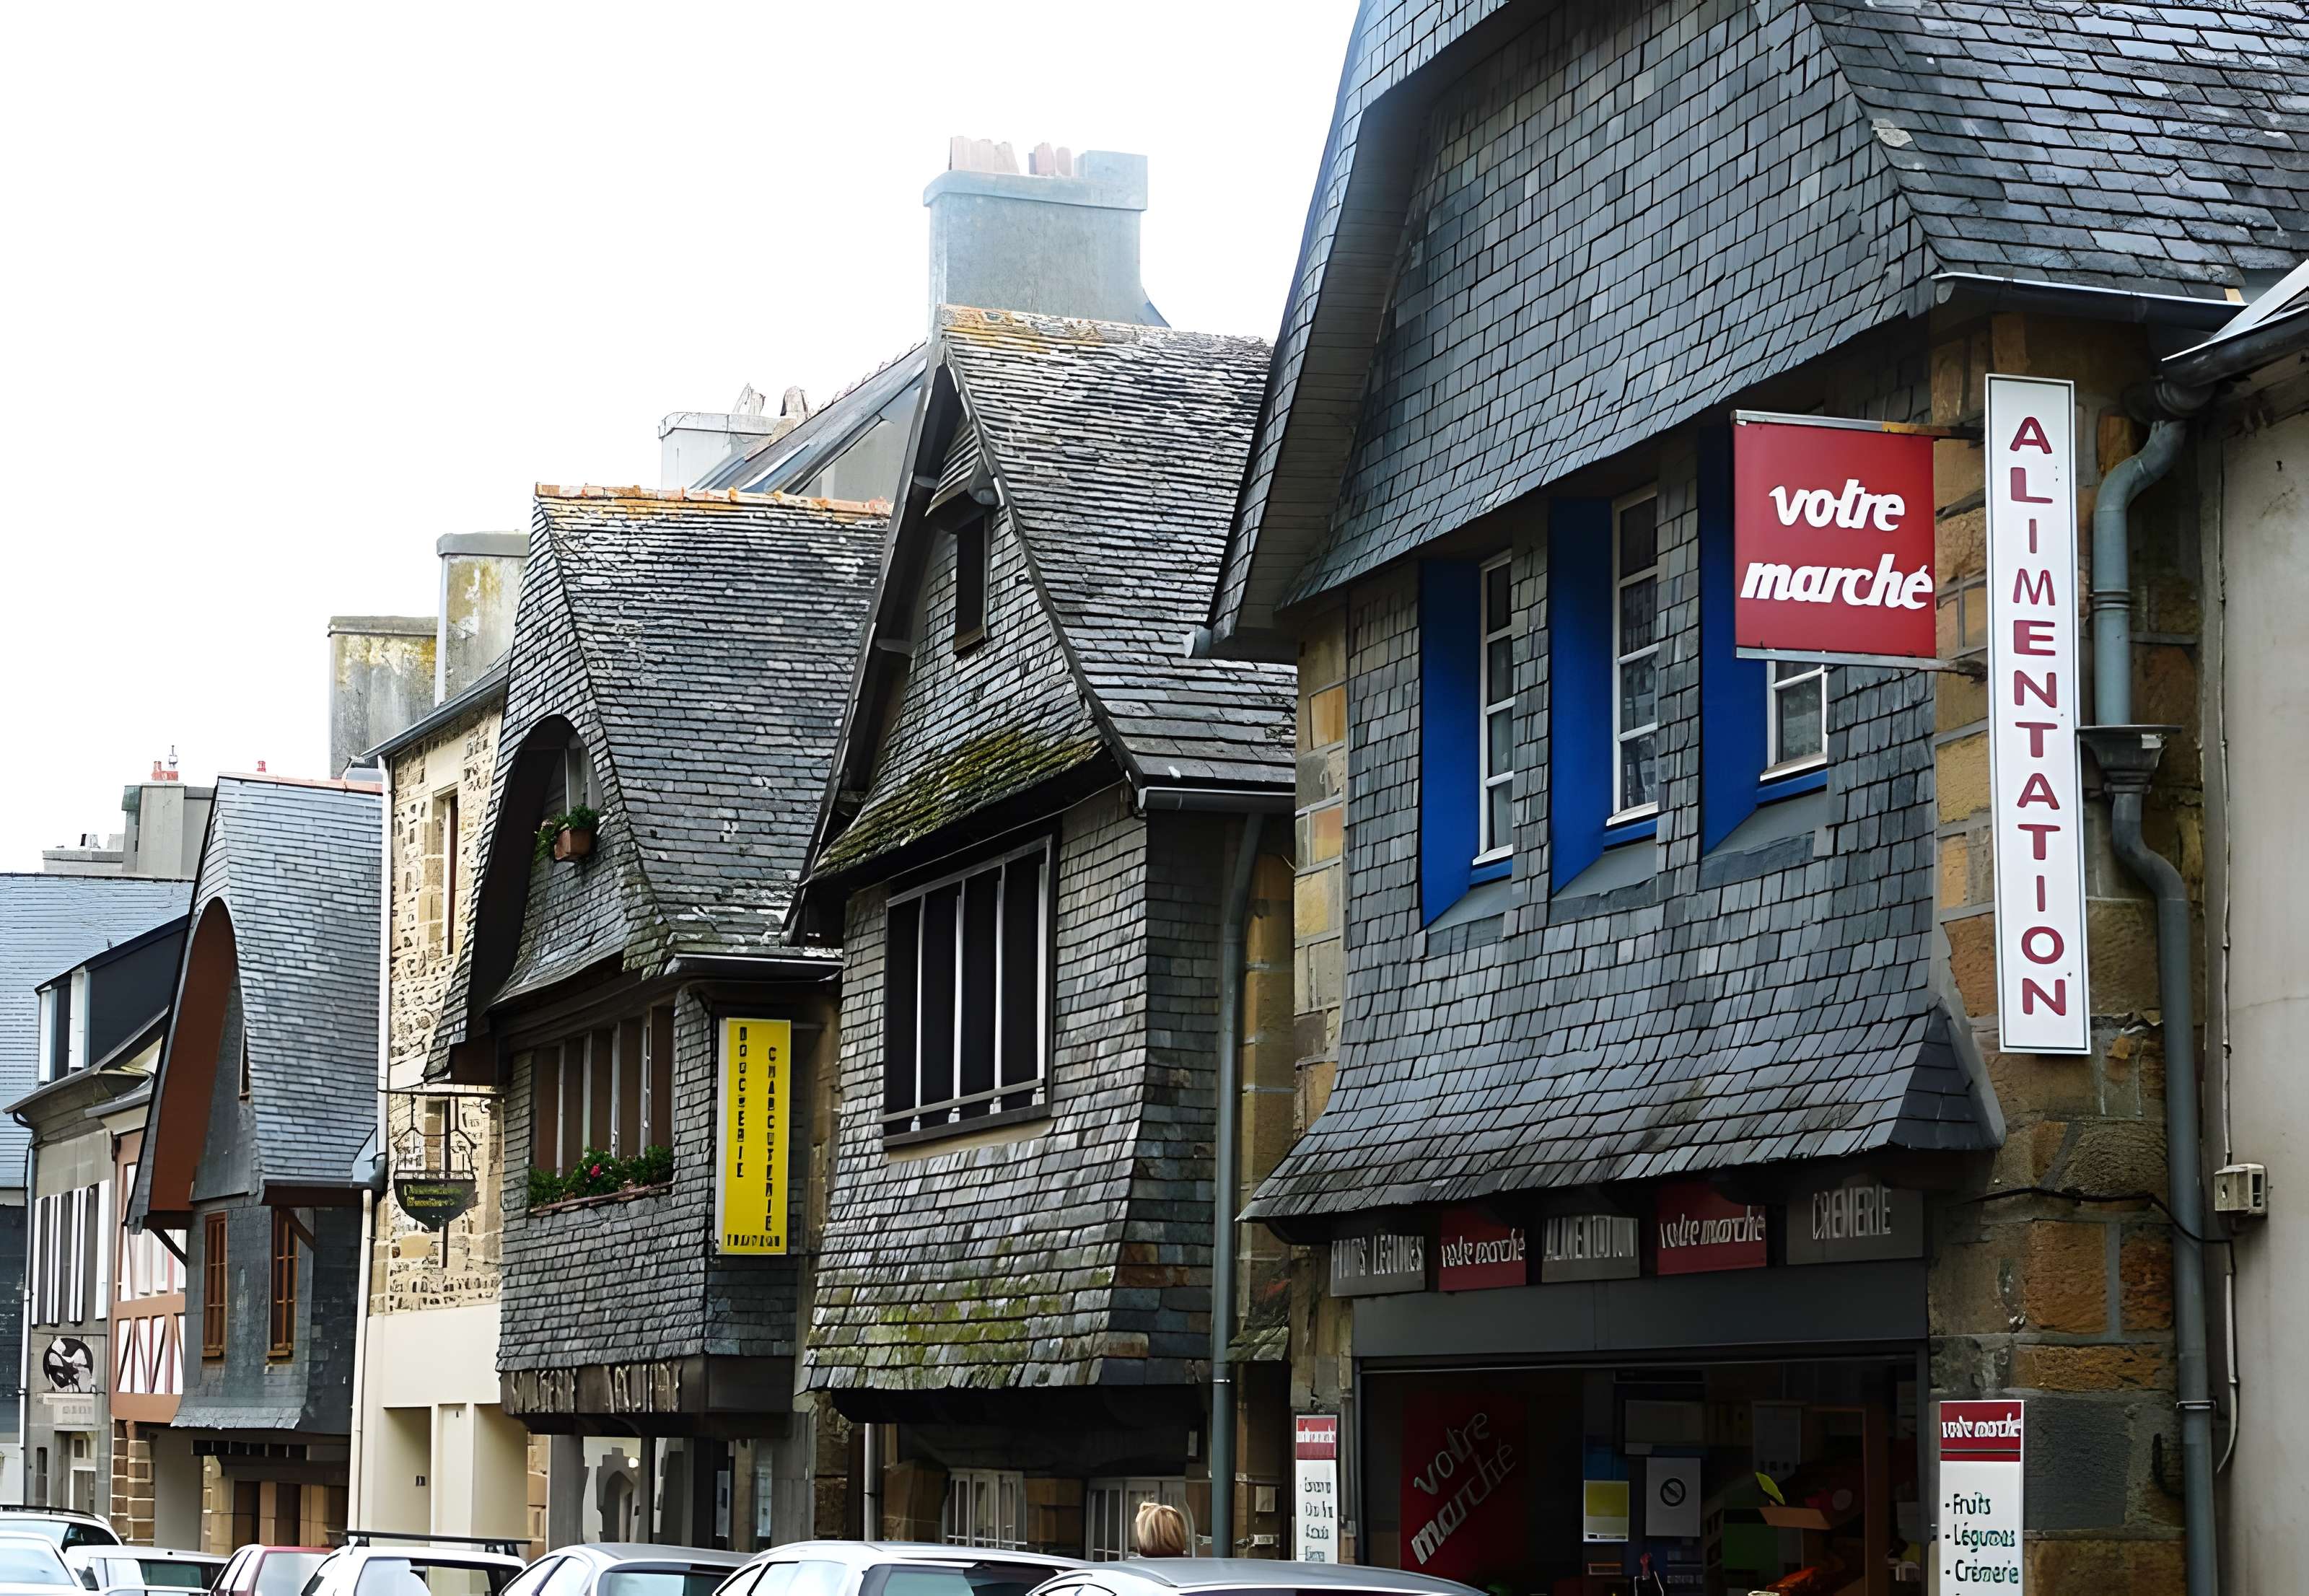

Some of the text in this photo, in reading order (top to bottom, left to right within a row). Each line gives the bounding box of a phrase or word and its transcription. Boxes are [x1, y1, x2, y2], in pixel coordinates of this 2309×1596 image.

[1769, 479, 1906, 532] votre
[1740, 553, 1934, 610] marché
[2010, 416, 2066, 1017] ALIMENTATION
